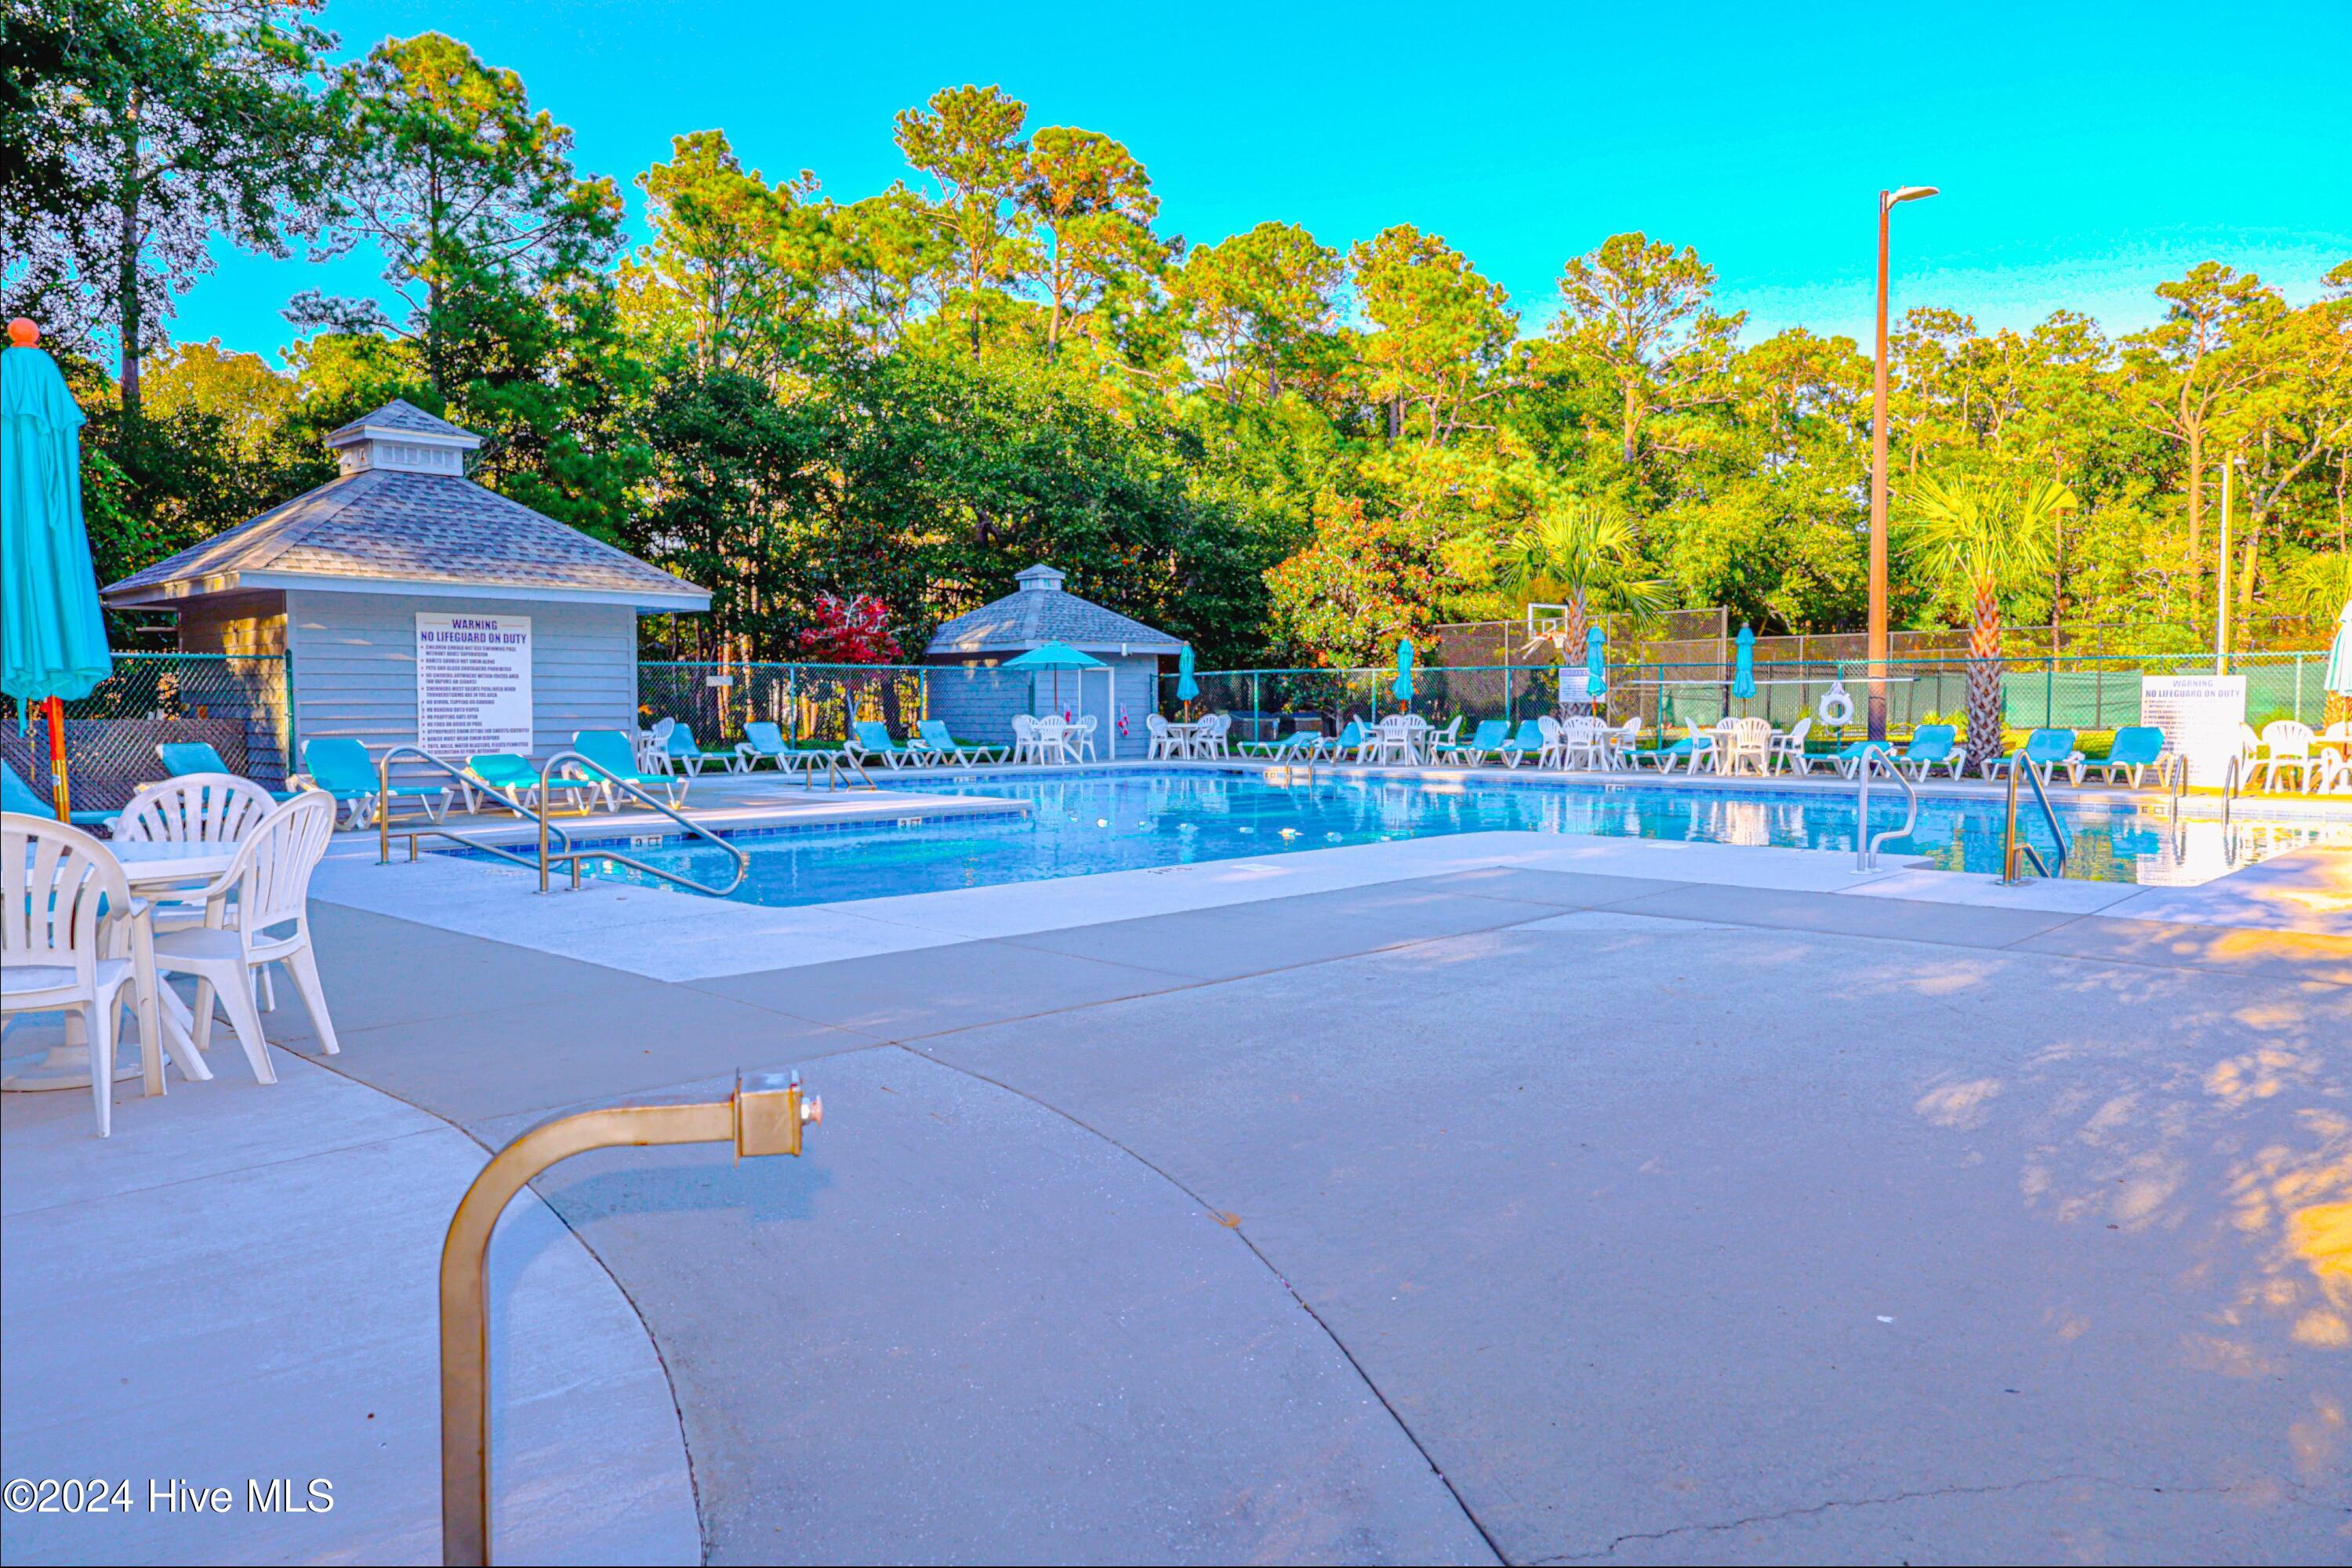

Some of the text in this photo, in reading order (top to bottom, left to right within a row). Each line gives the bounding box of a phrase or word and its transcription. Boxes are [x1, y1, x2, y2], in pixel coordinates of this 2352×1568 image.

[452, 619, 497, 630] WARNING
[421, 631, 526, 644] NO LIFEGUARD ON DUTY
[2172, 679, 2213, 688] WARNING
